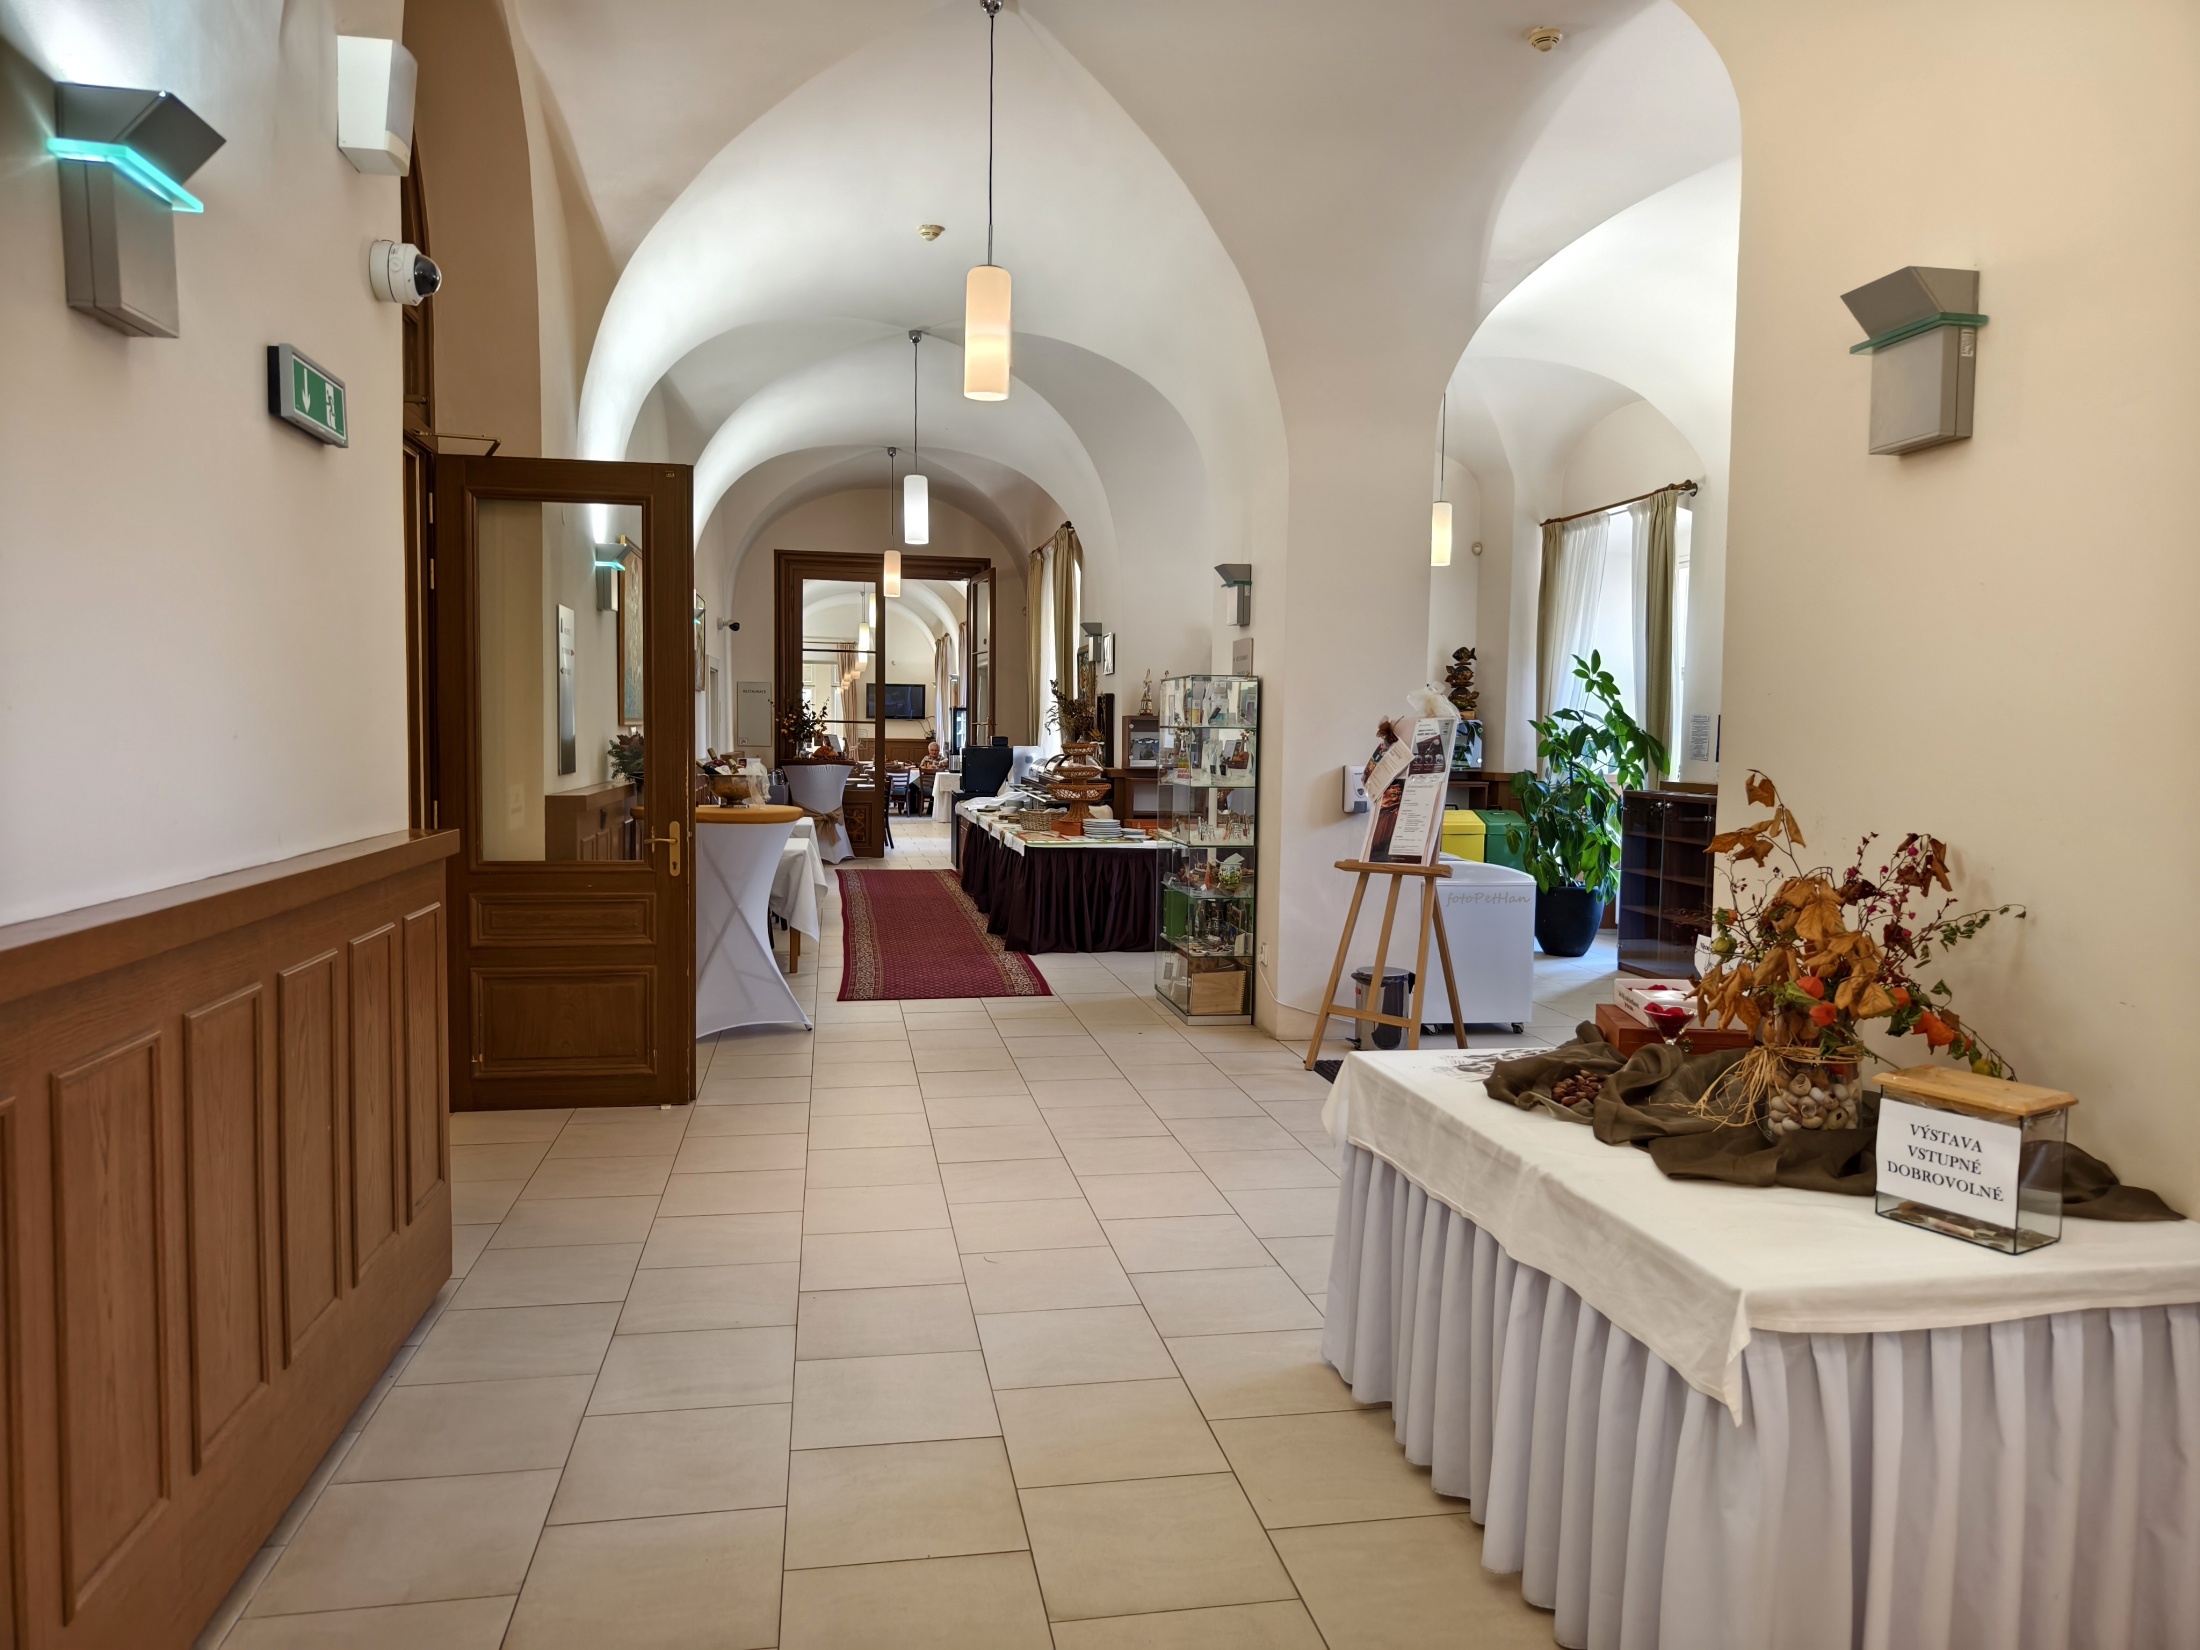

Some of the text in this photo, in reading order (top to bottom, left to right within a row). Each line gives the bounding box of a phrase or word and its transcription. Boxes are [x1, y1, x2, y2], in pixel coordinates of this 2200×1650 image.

[1910, 1124, 1982, 1153] VÝSTAVA
[1908, 1145, 1981, 1175] VSTUPNÉ
[1887, 1161, 2004, 1202] DOBROVOLNÉ
